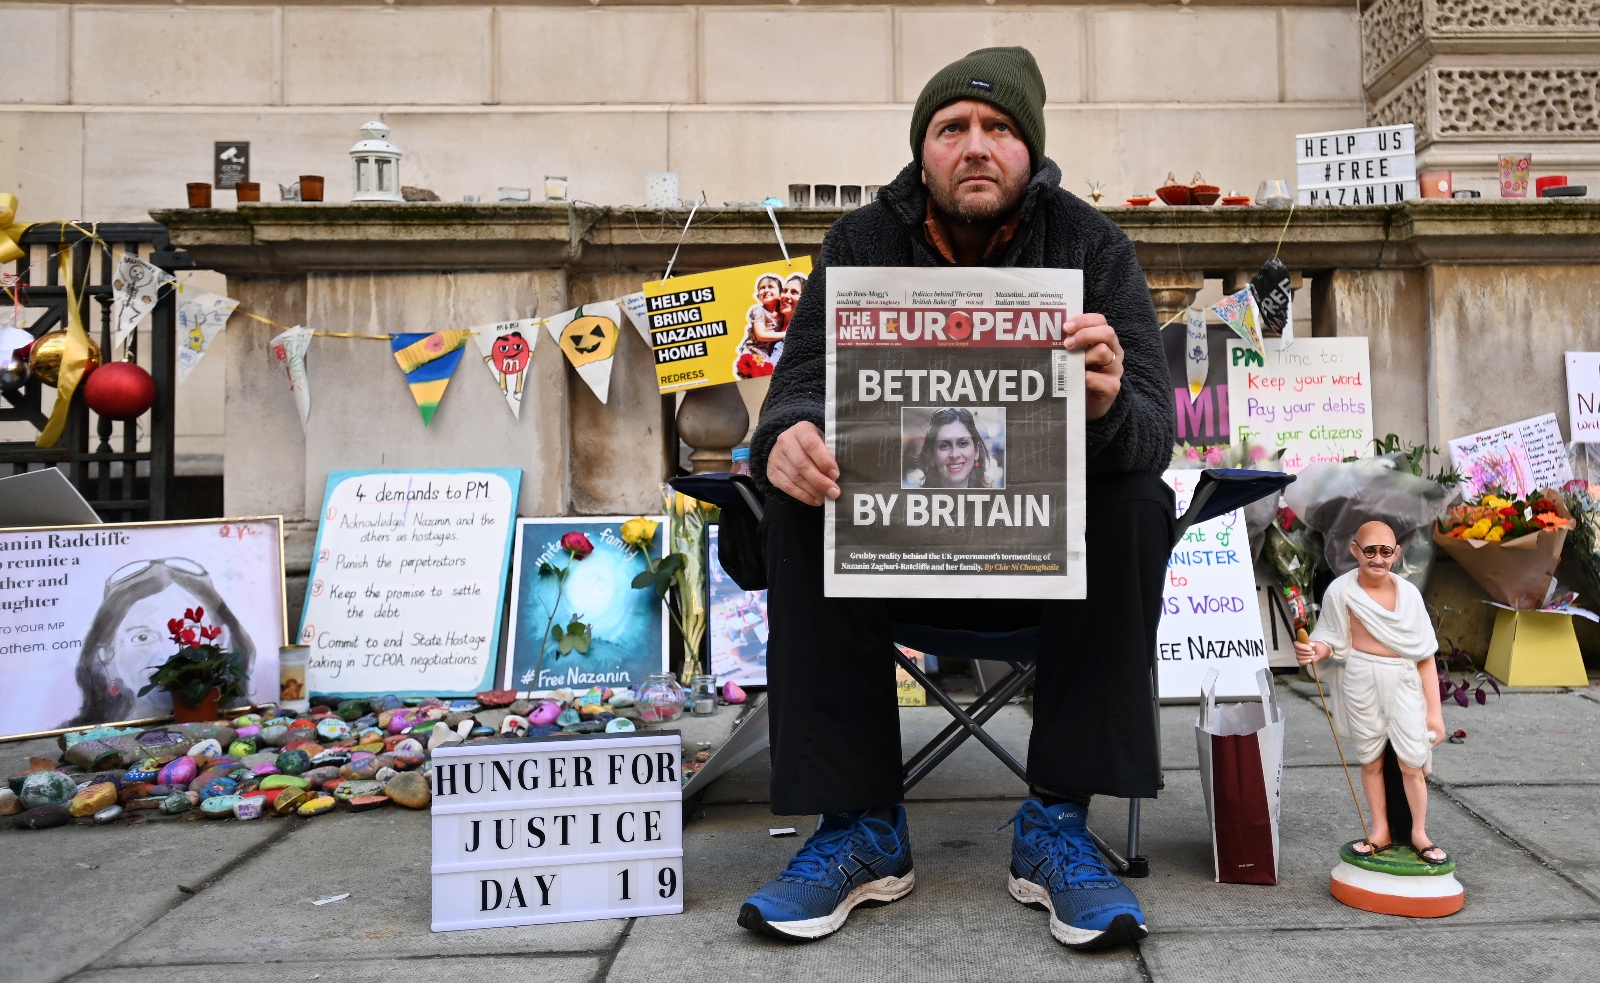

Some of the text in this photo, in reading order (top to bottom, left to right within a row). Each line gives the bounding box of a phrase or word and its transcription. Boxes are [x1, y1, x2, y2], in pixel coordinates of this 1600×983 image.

[1305, 131, 1402, 158] HELP US
[1324, 158, 1389, 182] #FREE
[650, 293, 689, 311] HELP
[691, 288, 714, 304] US
[653, 308, 701, 328] BRING
[839, 311, 872, 325] THE
[879, 310, 1062, 341] EUROPEAN
[655, 322, 725, 346] NAZANIN
[840, 325, 877, 340] NEW
[658, 343, 705, 363] HOME
[1231, 346, 1264, 368] PM
[660, 369, 706, 385] REDRESS
[858, 369, 1045, 402] BETRAYED
[1247, 371, 1364, 392] Keep your word
[1247, 397, 1366, 423] Pay your debts
[1275, 424, 1364, 447] your citizens
[355, 483, 367, 503] 4
[375, 481, 440, 503] demands
[446, 483, 462, 500] to
[412, 511, 451, 527] Nazanin
[455, 511, 475, 526] and
[480, 510, 496, 526] the
[853, 493, 1050, 527] BY BRITAIN
[48, 530, 131, 549] Radcliffe
[360, 529, 391, 543] others
[396, 532, 408, 542] as
[1215, 525, 1234, 548] of
[7, 554, 68, 570] reunite
[71, 556, 80, 566] a
[335, 552, 369, 570] Punish
[377, 552, 392, 568] the
[850, 552, 877, 561] Grubby
[878, 552, 901, 561] reality
[953, 552, 1001, 561] government's
[1001, 553, 1042, 562] tormenting
[1042, 553, 1052, 561] of
[931, 563, 945, 571] and
[945, 563, 958, 571] her
[984, 563, 994, 573] By
[1169, 569, 1188, 588] to
[38, 572, 69, 588] and
[329, 584, 357, 605] Keep
[364, 582, 381, 599] the
[385, 582, 426, 603] promise
[430, 582, 443, 597] to
[451, 582, 482, 597] settle
[0, 595, 59, 614] ughter
[346, 603, 401, 619] the debt
[1187, 594, 1245, 615] WORD
[15, 623, 44, 634] YOUR
[47, 621, 65, 631] MP
[317, 630, 360, 650] Commit
[365, 634, 379, 648] to
[383, 630, 404, 648] end
[410, 631, 443, 647] State
[444, 630, 487, 650] Hostage
[1187, 635, 1265, 661] NAZANIN
[308, 652, 343, 679] taking
[346, 652, 356, 667] in
[566, 665, 631, 686] Nazanin
[434, 751, 678, 797] HUNGER FOR
[464, 810, 662, 853] JUSTICE
[479, 873, 558, 912] DAY
